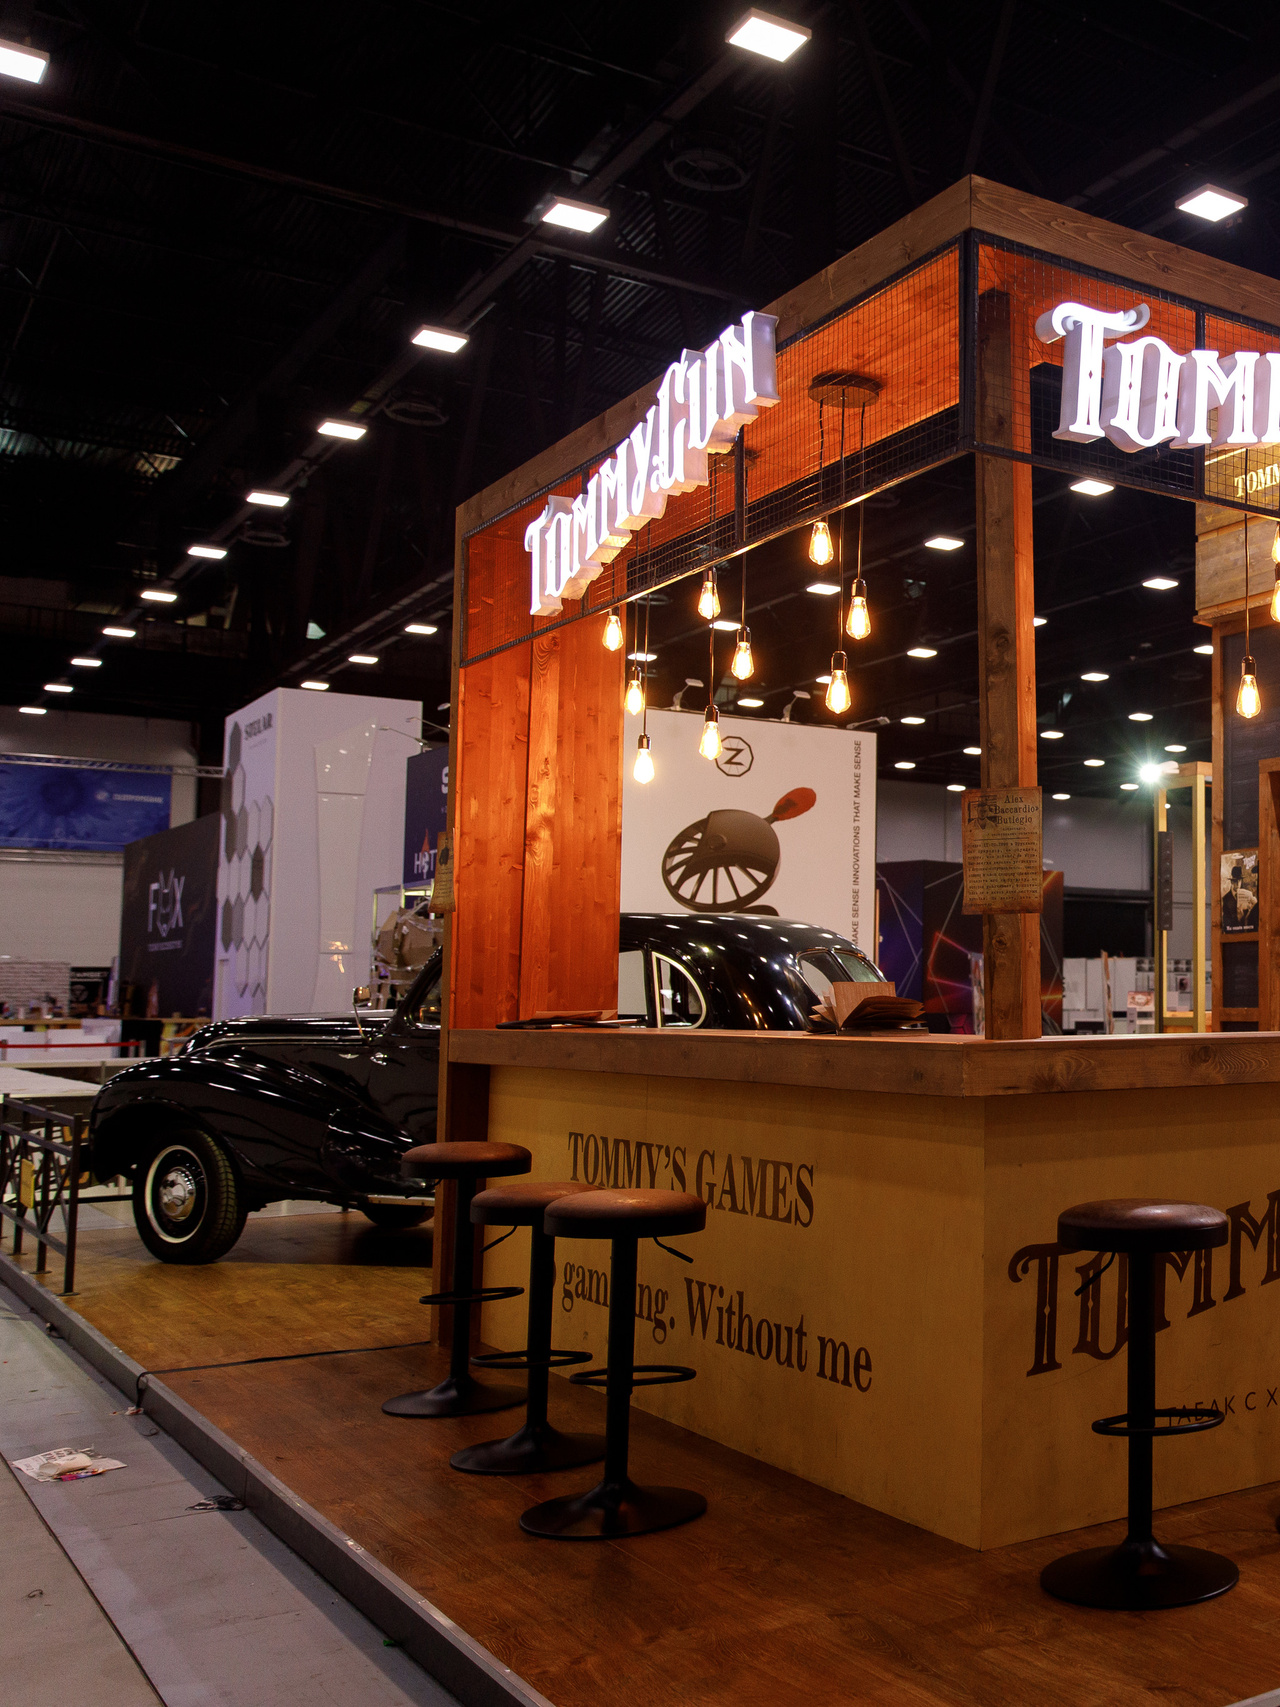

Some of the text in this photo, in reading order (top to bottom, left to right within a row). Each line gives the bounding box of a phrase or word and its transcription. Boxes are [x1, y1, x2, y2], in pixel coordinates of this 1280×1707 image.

[854, 740, 862, 770] SENSE
[853, 800, 861, 823] THAT
[852, 825, 861, 886] INNOVATIONS
[852, 888, 860, 918] SENSE
[568, 1131, 815, 1229] TOMMY'S GAMES
[683, 1276, 808, 1373] Without
[816, 1335, 872, 1393] me
